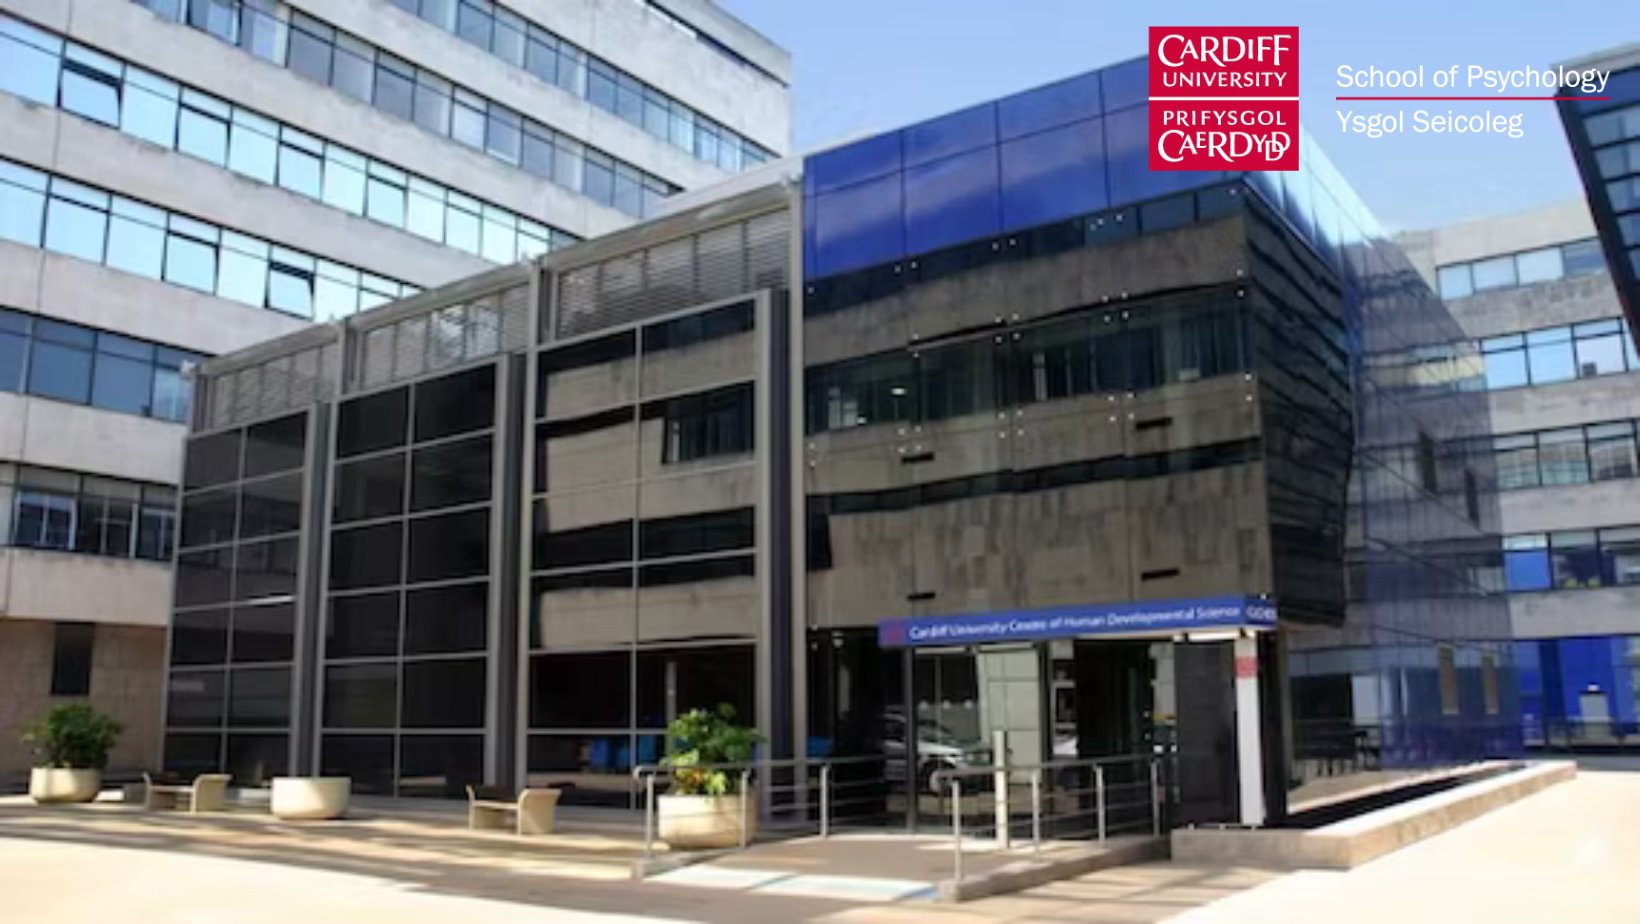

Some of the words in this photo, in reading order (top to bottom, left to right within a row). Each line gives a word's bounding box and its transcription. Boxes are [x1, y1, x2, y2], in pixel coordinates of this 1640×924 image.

[908, 624, 947, 639] Cardiff
[949, 621, 1009, 638] University
[1009, 617, 1046, 632] Centre
[1063, 614, 1105, 628] Human
[1107, 607, 1194, 627] Developmental
[1196, 605, 1240, 620] Science
